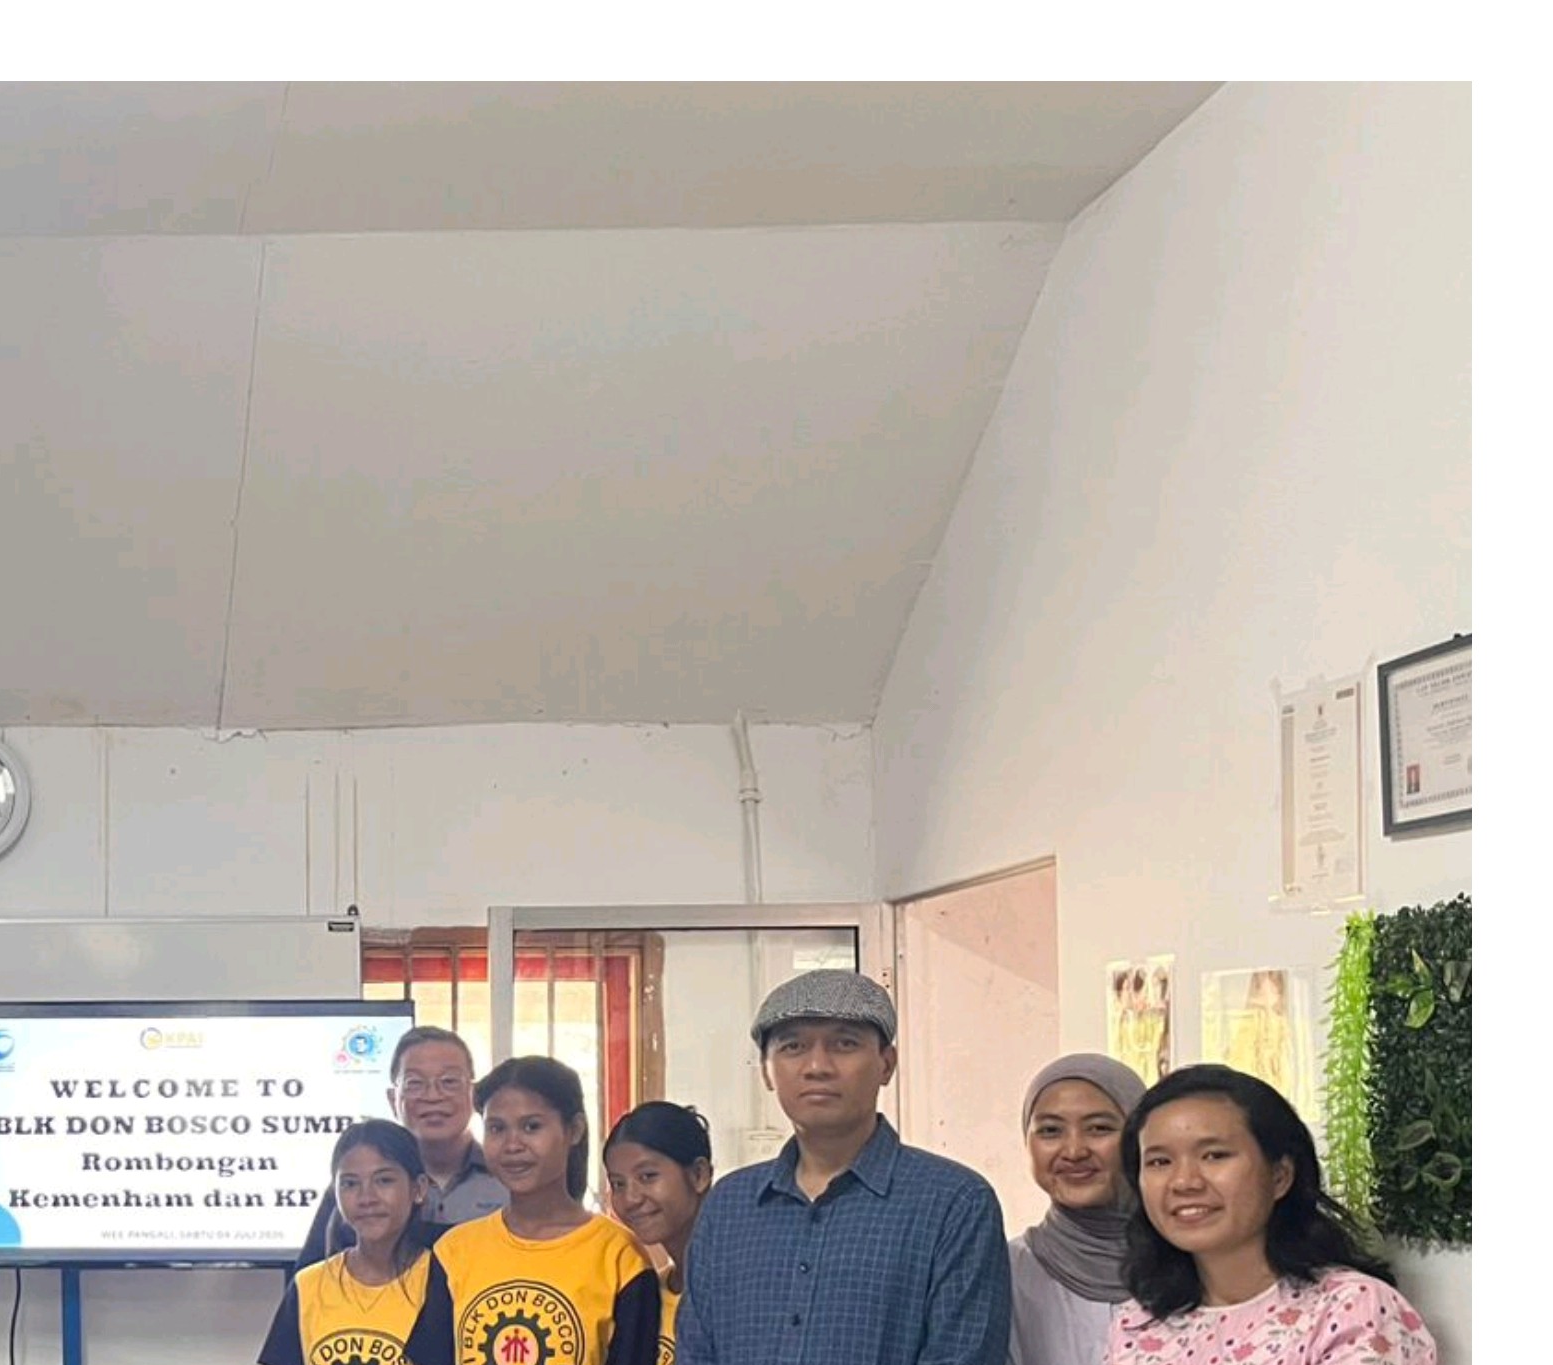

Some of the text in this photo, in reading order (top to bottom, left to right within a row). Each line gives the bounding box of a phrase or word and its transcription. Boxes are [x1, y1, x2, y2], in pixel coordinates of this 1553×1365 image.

[49, 1079, 304, 1098] WELCOME TO
[66, 1115, 135, 1135] DON
[145, 1115, 251, 1135] BOSCO
[262, 1115, 373, 1134] SUMB
[82, 1153, 278, 1177] Rombongan
[9, 1189, 193, 1208] Kemenham
[204, 1189, 264, 1208] dan
[464, 1290, 574, 1355] BLK DON BOSCO
[319, 1337, 364, 1362] DON
